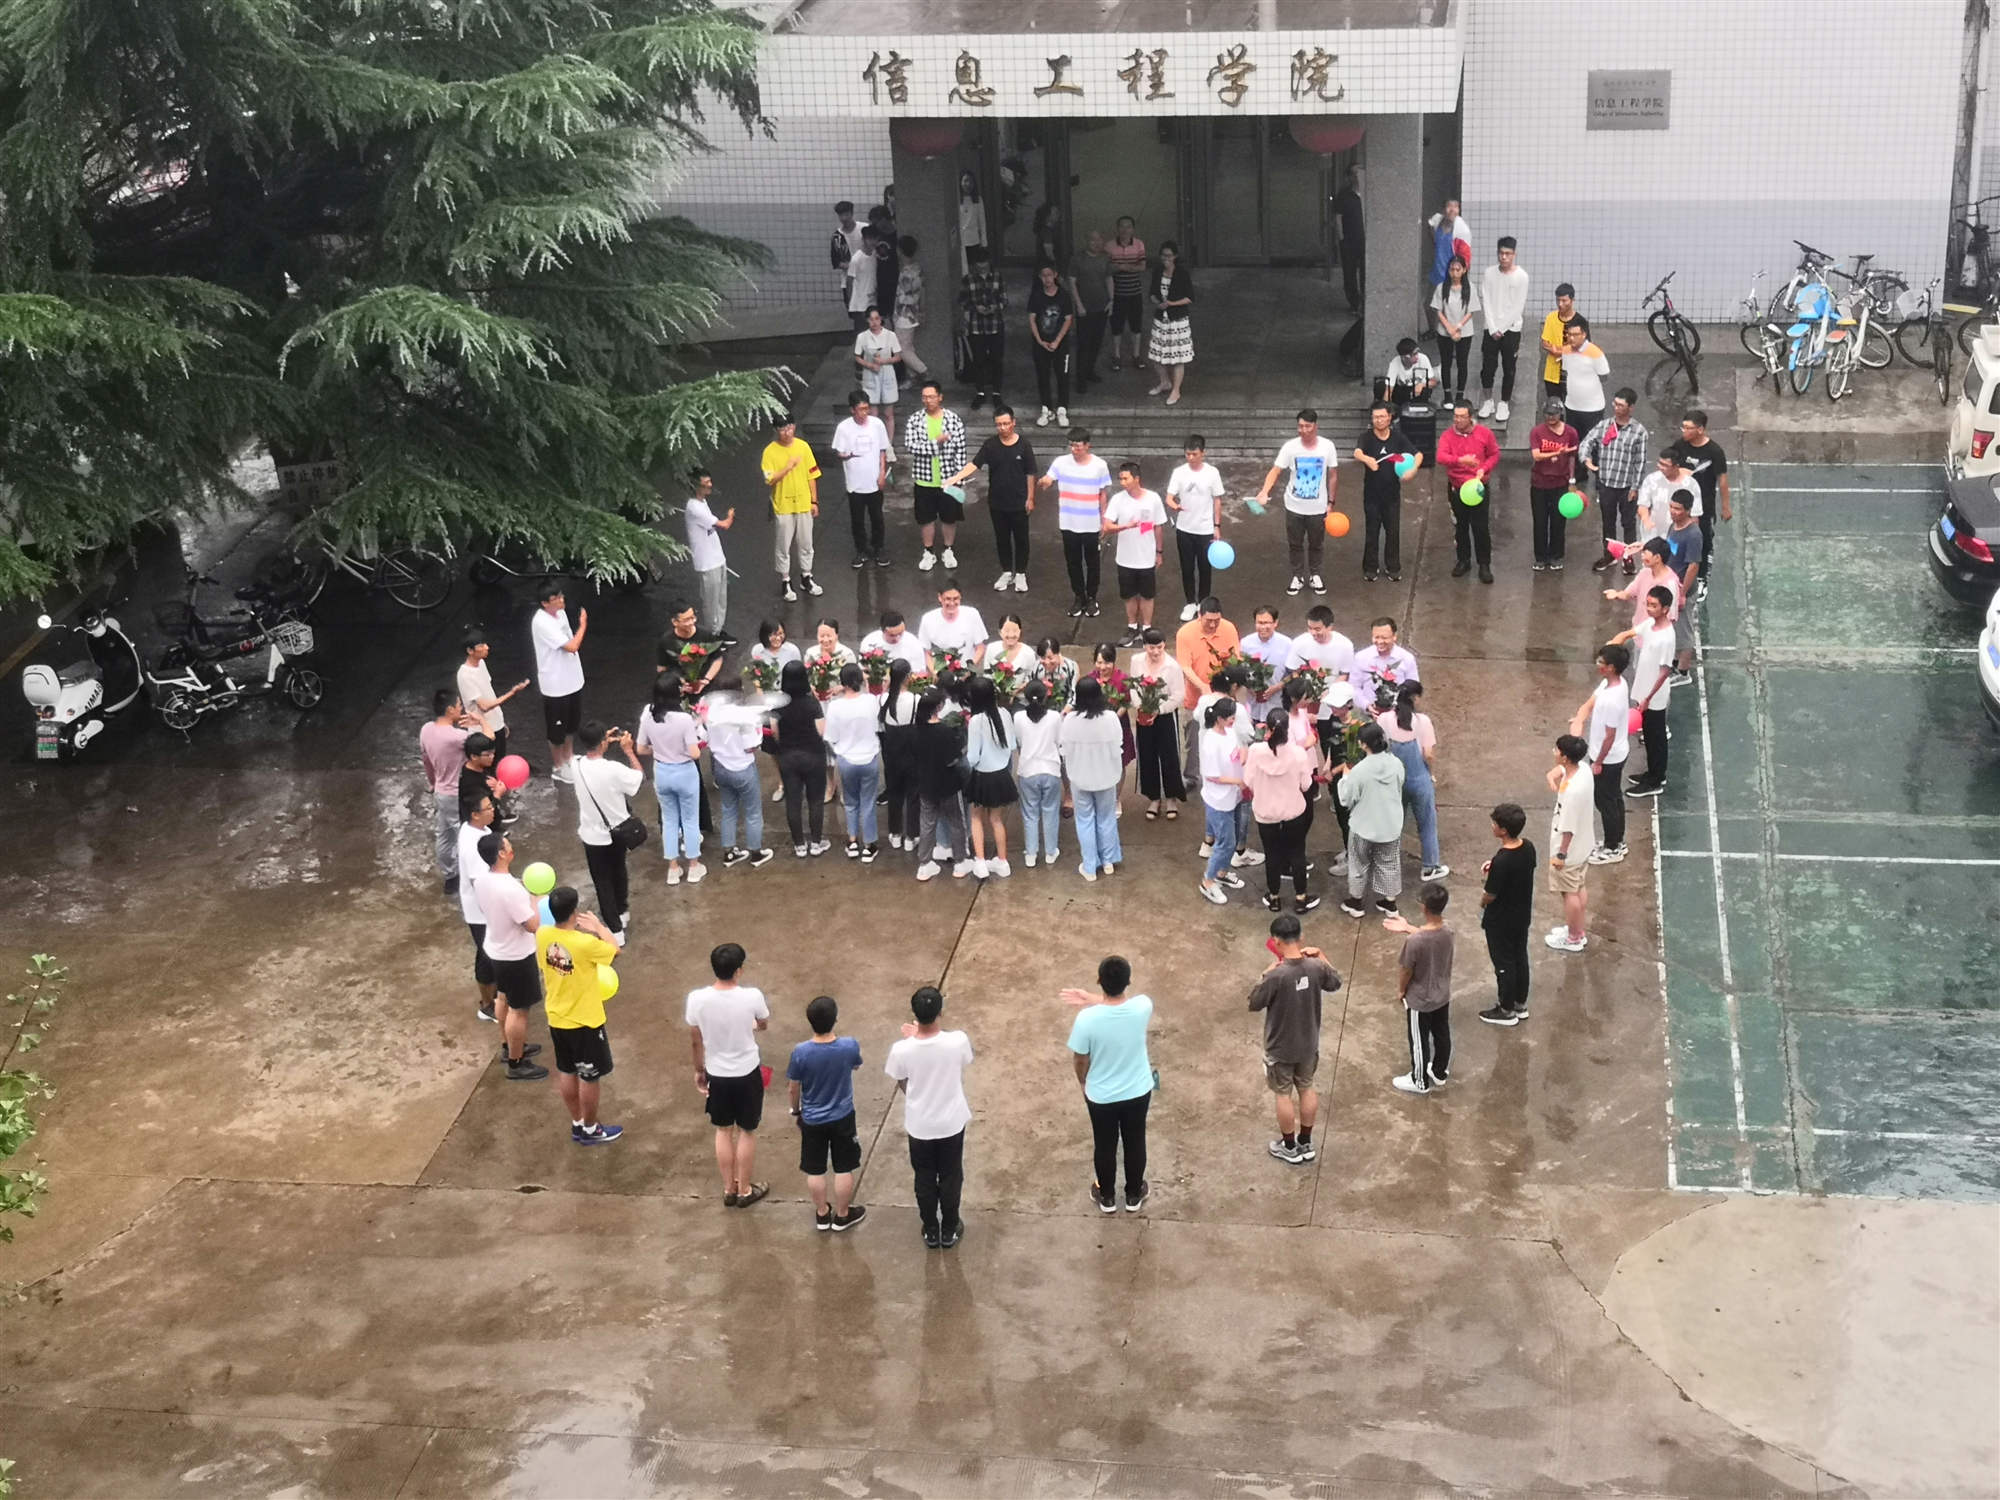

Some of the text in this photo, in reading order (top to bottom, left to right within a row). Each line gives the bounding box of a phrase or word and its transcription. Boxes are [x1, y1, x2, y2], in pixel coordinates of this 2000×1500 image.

[862, 42, 1345, 107] 信息工程学院
